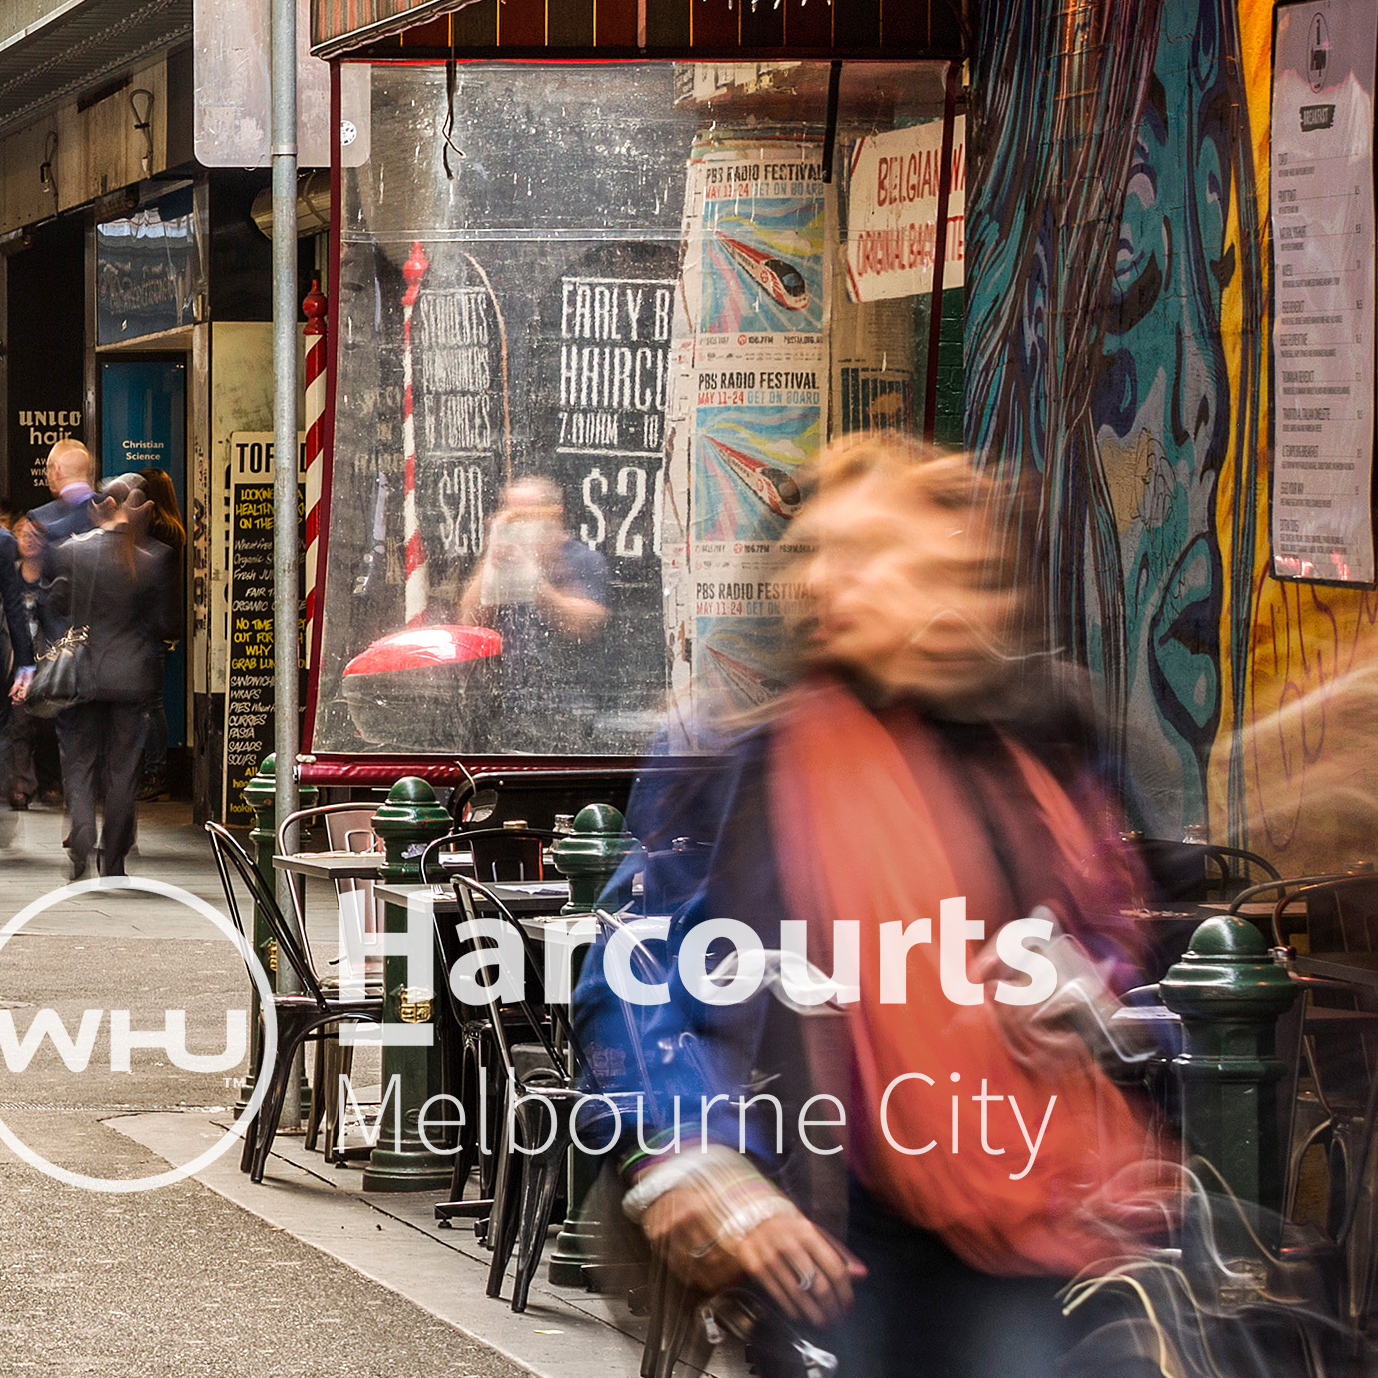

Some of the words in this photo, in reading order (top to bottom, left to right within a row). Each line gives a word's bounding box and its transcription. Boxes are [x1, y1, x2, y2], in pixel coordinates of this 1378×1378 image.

[728, 166, 760, 181] RADIO
[764, 163, 823, 180] FESTIVAL
[705, 185, 721, 199] MAY
[774, 183, 787, 195] ON
[791, 182, 824, 196] BOARD
[561, 283, 644, 341] EARLY
[698, 374, 717, 390] PBS
[720, 374, 755, 390] RADIO
[759, 372, 820, 389] FESTIVAL
[697, 392, 715, 405] MAY
[718, 391, 745, 404] 11-24
[747, 391, 765, 404] GET
[769, 391, 783, 404] ON
[786, 391, 820, 404] BOARD
[18, 410, 82, 427] UNICO
[29, 426, 72, 446] hair
[122, 440, 164, 450] Christian
[125, 452, 161, 461] Science
[439, 467, 483, 555] $20
[239, 518, 252, 529] ON
[255, 518, 274, 530] THE
[234, 554, 265, 569] Organic
[233, 569, 256, 581] Fresh
[259, 570, 274, 580] JUI
[246, 586, 266, 598] FAIR
[696, 583, 715, 599] PBS
[718, 583, 753, 600] RADIO
[232, 600, 269, 612] ORGANIC
[696, 602, 713, 615] MAY
[716, 602, 742, 615] 11-24
[236, 618, 249, 630] NO
[252, 619, 273, 630] TIME
[234, 632, 250, 643] OUT
[257, 632, 274, 643] FOR
[246, 645, 272, 656] WHY
[232, 658, 257, 671] GRAB
[260, 659, 275, 670] LUN
[230, 689, 262, 700] WRAPS
[229, 702, 251, 714] PIES
[229, 714, 267, 727] CURRIES
[229, 727, 255, 739] PASTA
[228, 742, 263, 753] SALADS
[228, 755, 257, 767] SOUPS
